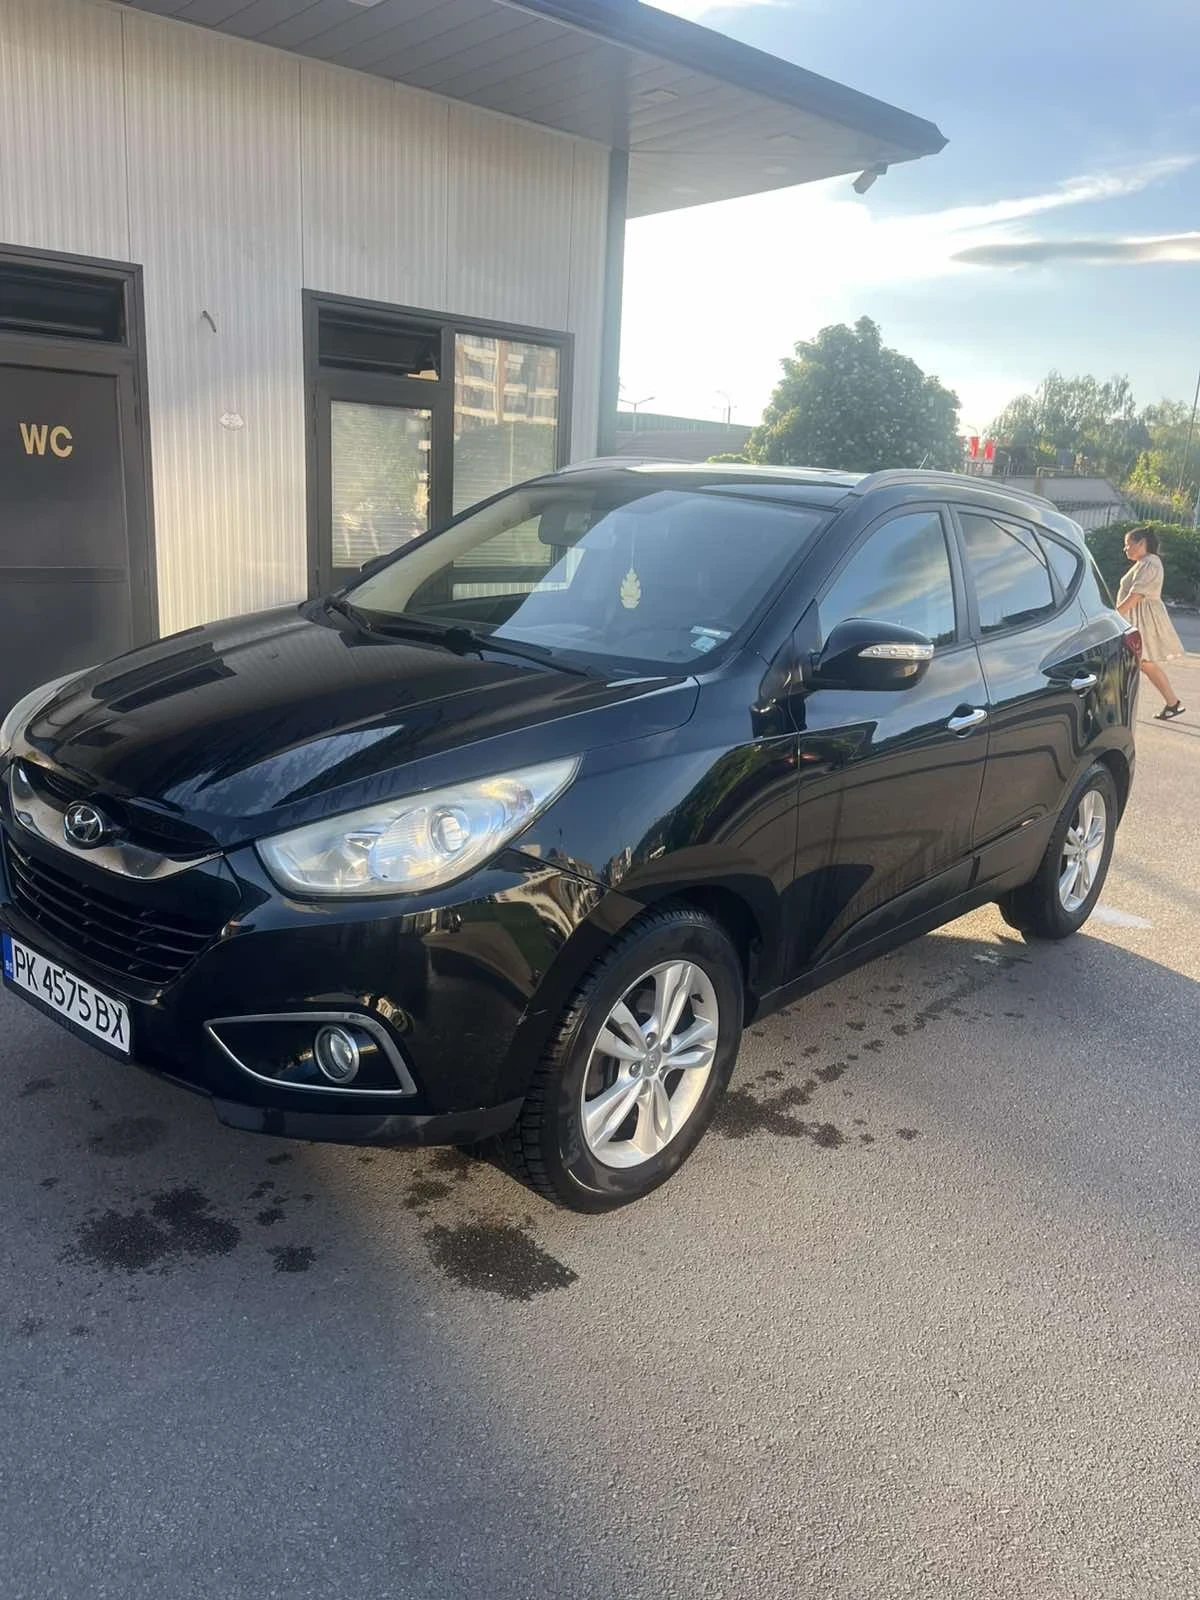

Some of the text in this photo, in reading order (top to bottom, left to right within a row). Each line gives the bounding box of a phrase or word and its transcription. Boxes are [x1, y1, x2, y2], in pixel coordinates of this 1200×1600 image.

[20, 423, 73, 458] WC
[14, 945, 125, 1044] PK 4575 BX
